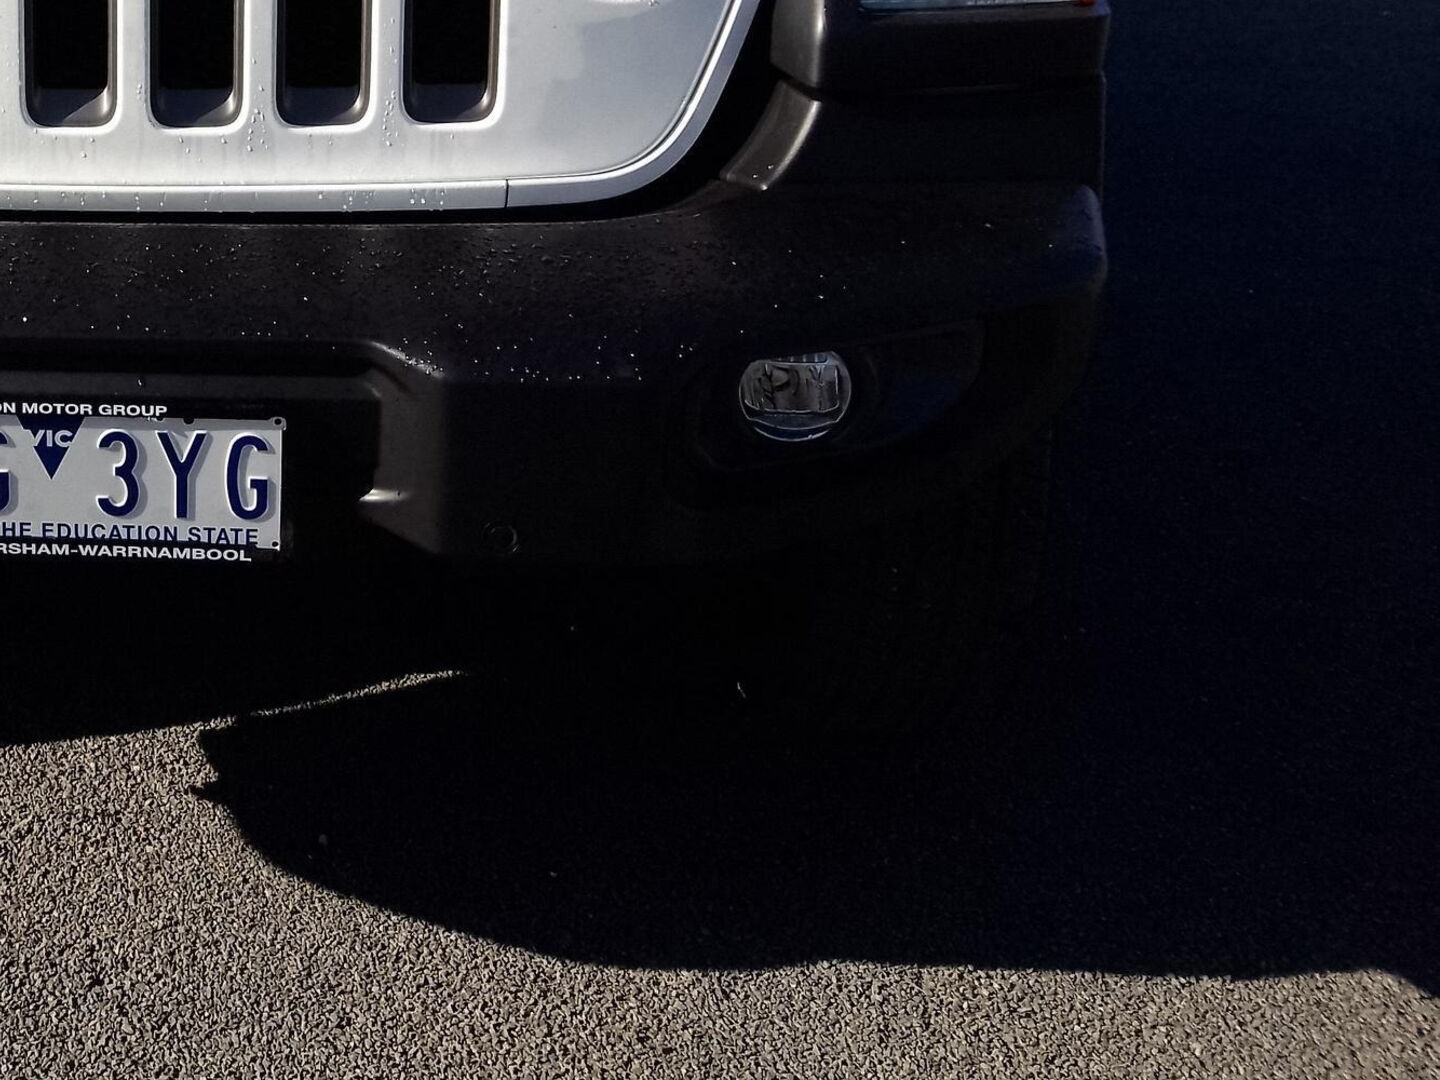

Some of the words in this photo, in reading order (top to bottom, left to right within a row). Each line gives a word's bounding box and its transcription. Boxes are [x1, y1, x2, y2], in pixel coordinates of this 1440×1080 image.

[21, 402, 92, 415] MOTOR
[98, 404, 167, 417] GROUP
[26, 429, 73, 447] VIC
[96, 429, 270, 521] 3YG
[41, 522, 178, 541] EDUCATION
[188, 526, 259, 545] STATE
